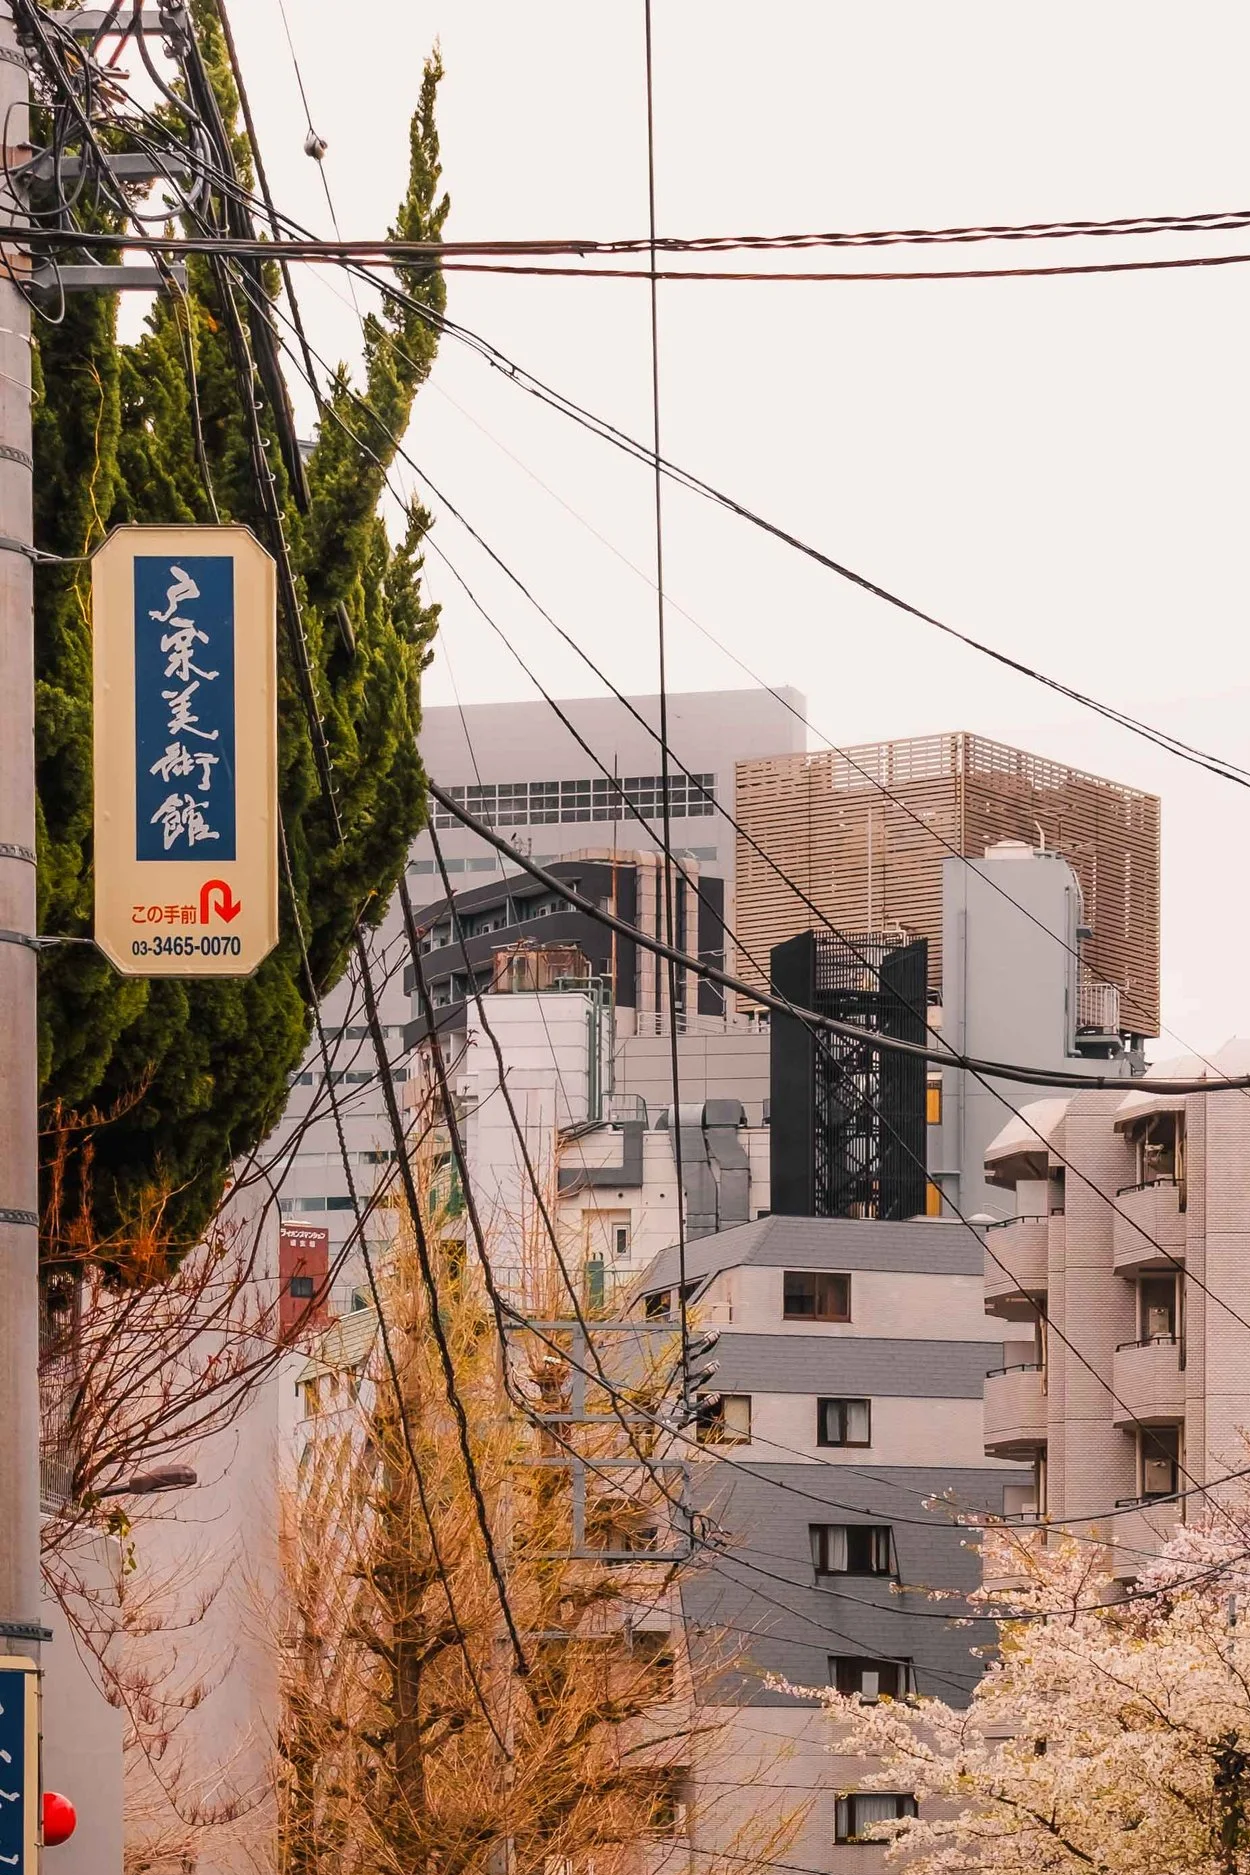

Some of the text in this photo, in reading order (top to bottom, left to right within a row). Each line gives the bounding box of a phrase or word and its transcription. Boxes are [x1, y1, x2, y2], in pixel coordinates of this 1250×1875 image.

[132, 905, 197, 924] この手前
[132, 936, 241, 956] 03-3465-0070
